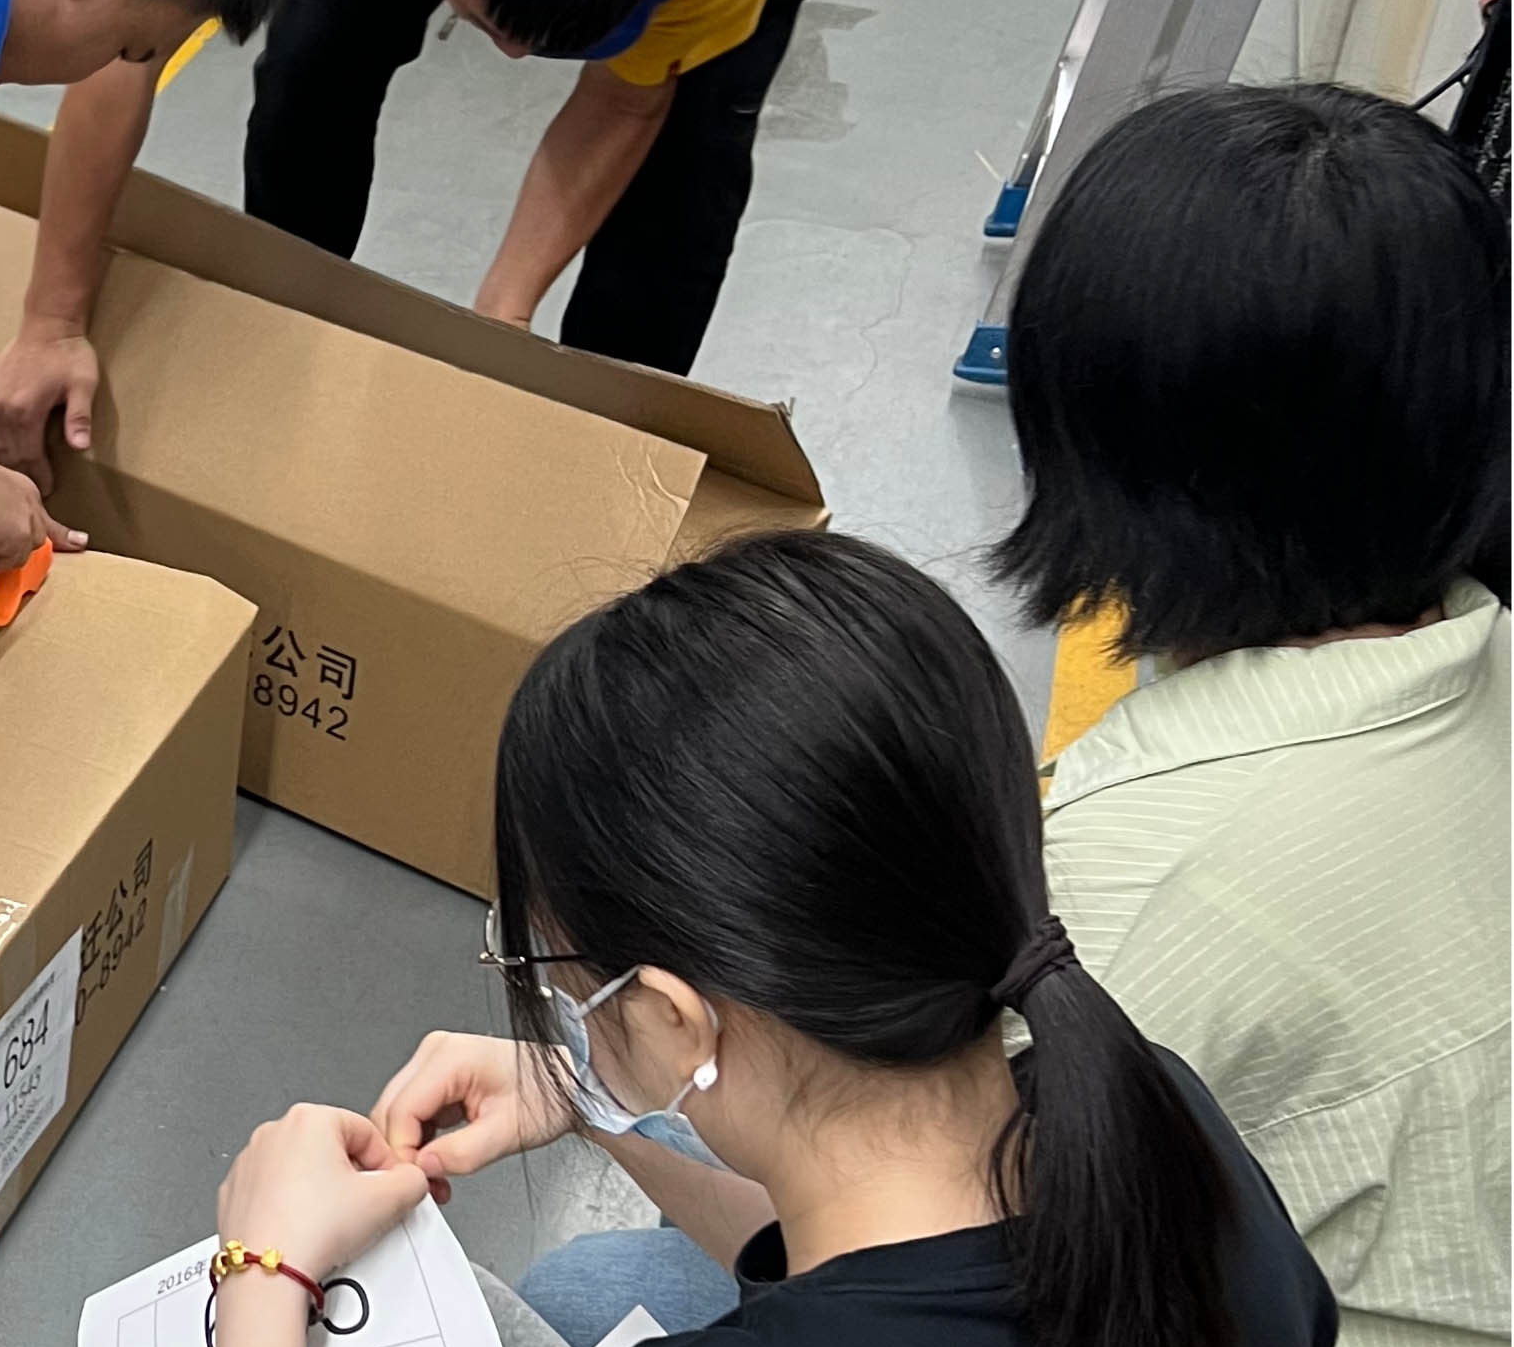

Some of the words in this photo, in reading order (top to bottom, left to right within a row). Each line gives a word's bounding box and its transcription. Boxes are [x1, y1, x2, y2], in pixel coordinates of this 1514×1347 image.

[261, 625, 357, 701] 公司
[253, 673, 349, 742] 8942
[3, 998, 49, 1089] 684
[156, 1258, 208, 1296] 2016年
